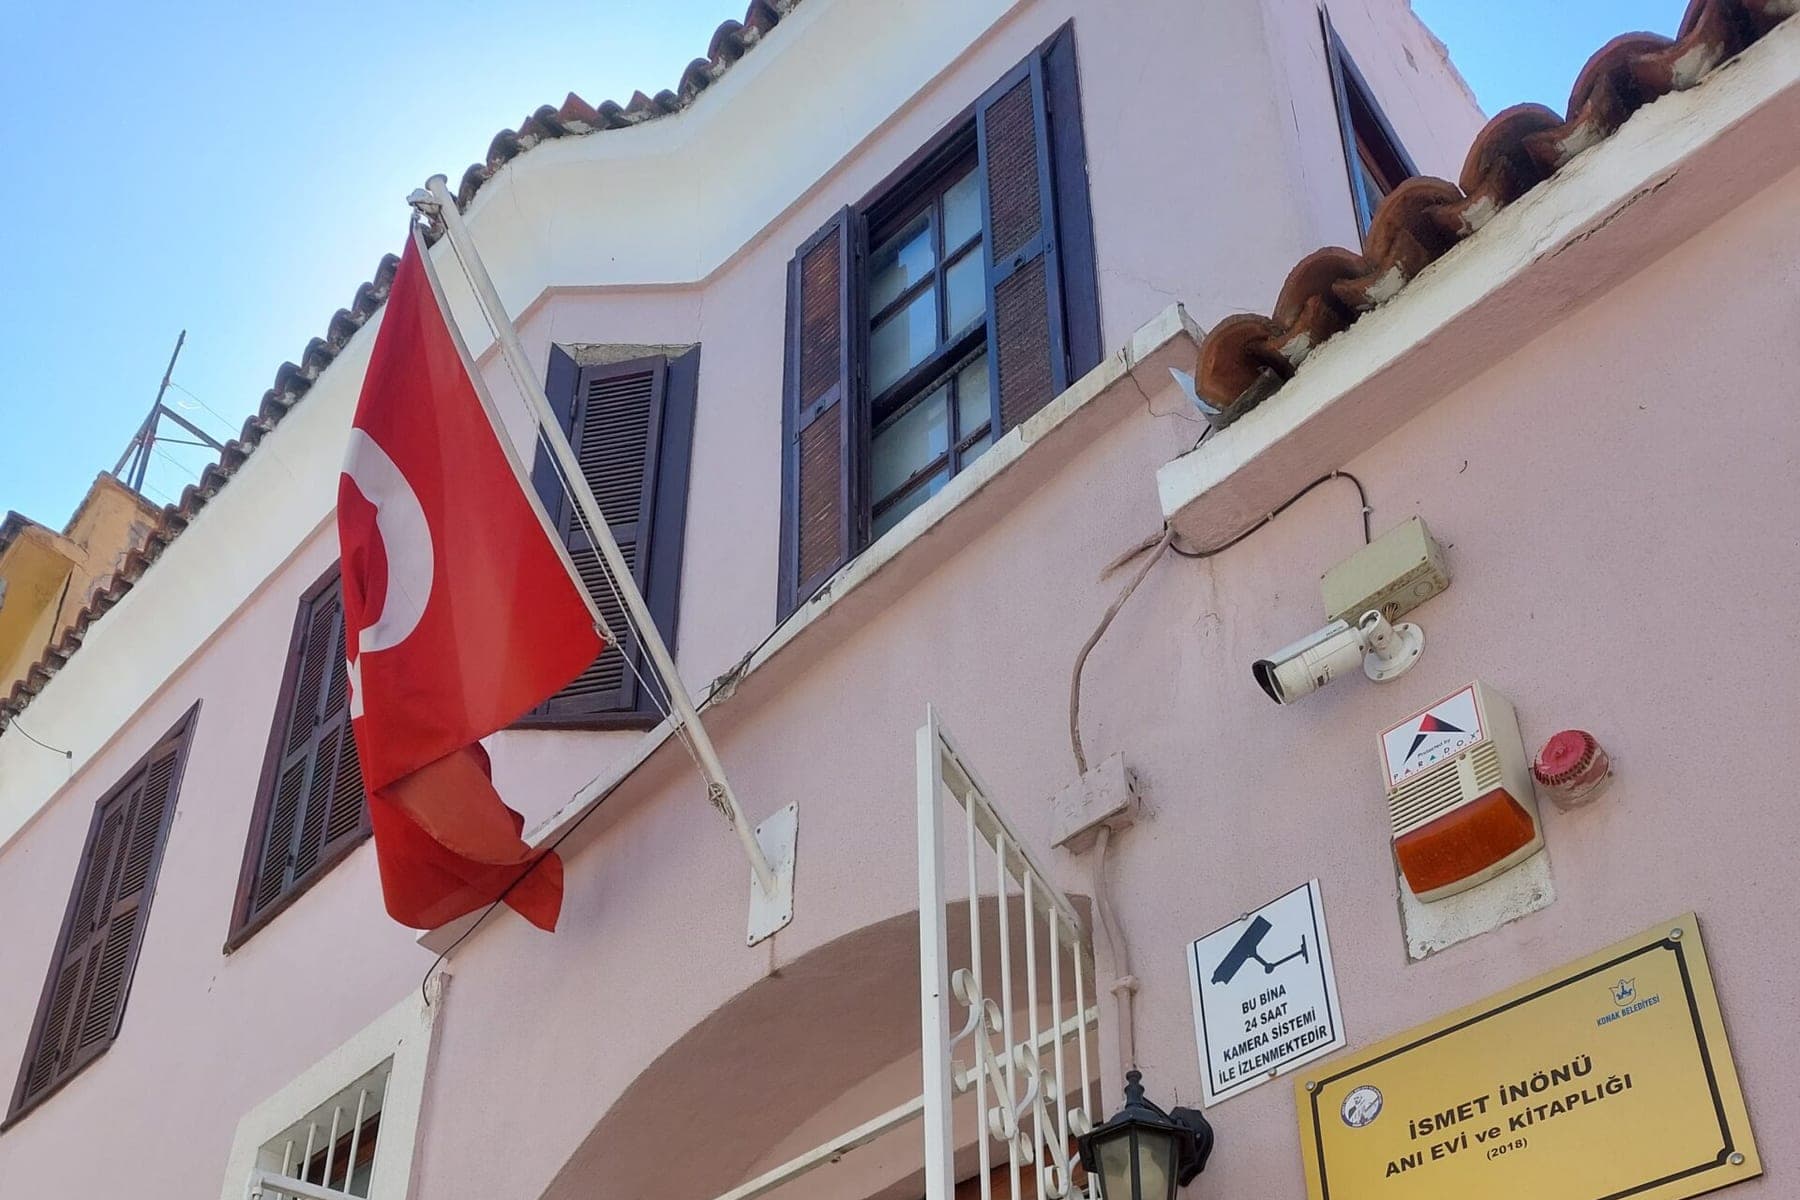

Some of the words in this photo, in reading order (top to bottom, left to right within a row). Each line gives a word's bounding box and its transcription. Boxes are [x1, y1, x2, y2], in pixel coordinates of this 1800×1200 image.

[1242, 998, 1257, 1014] BU
[1260, 984, 1286, 1007] BİNA
[1244, 1017, 1258, 1033] 24
[1260, 1002, 1288, 1026] SAAT
[1597, 1011, 1621, 1027] KONAK
[1219, 1068, 1236, 1085] İLE
[1238, 1024, 1328, 1077] İZLENMEKTEDİR
[1223, 1034, 1269, 1063] KAMERA
[1271, 1006, 1317, 1041] SİSTEMİ
[1409, 1094, 1490, 1140] İSMET
[1499, 1053, 1593, 1106] İNÖNÜ
[1385, 1151, 1423, 1178] ANI
[1430, 1131, 1468, 1161] EVİ
[1475, 1126, 1501, 1143] ve
[1508, 1073, 1633, 1132] KİTAPLIĞI
[1486, 1137, 1528, 1161] (2018)
